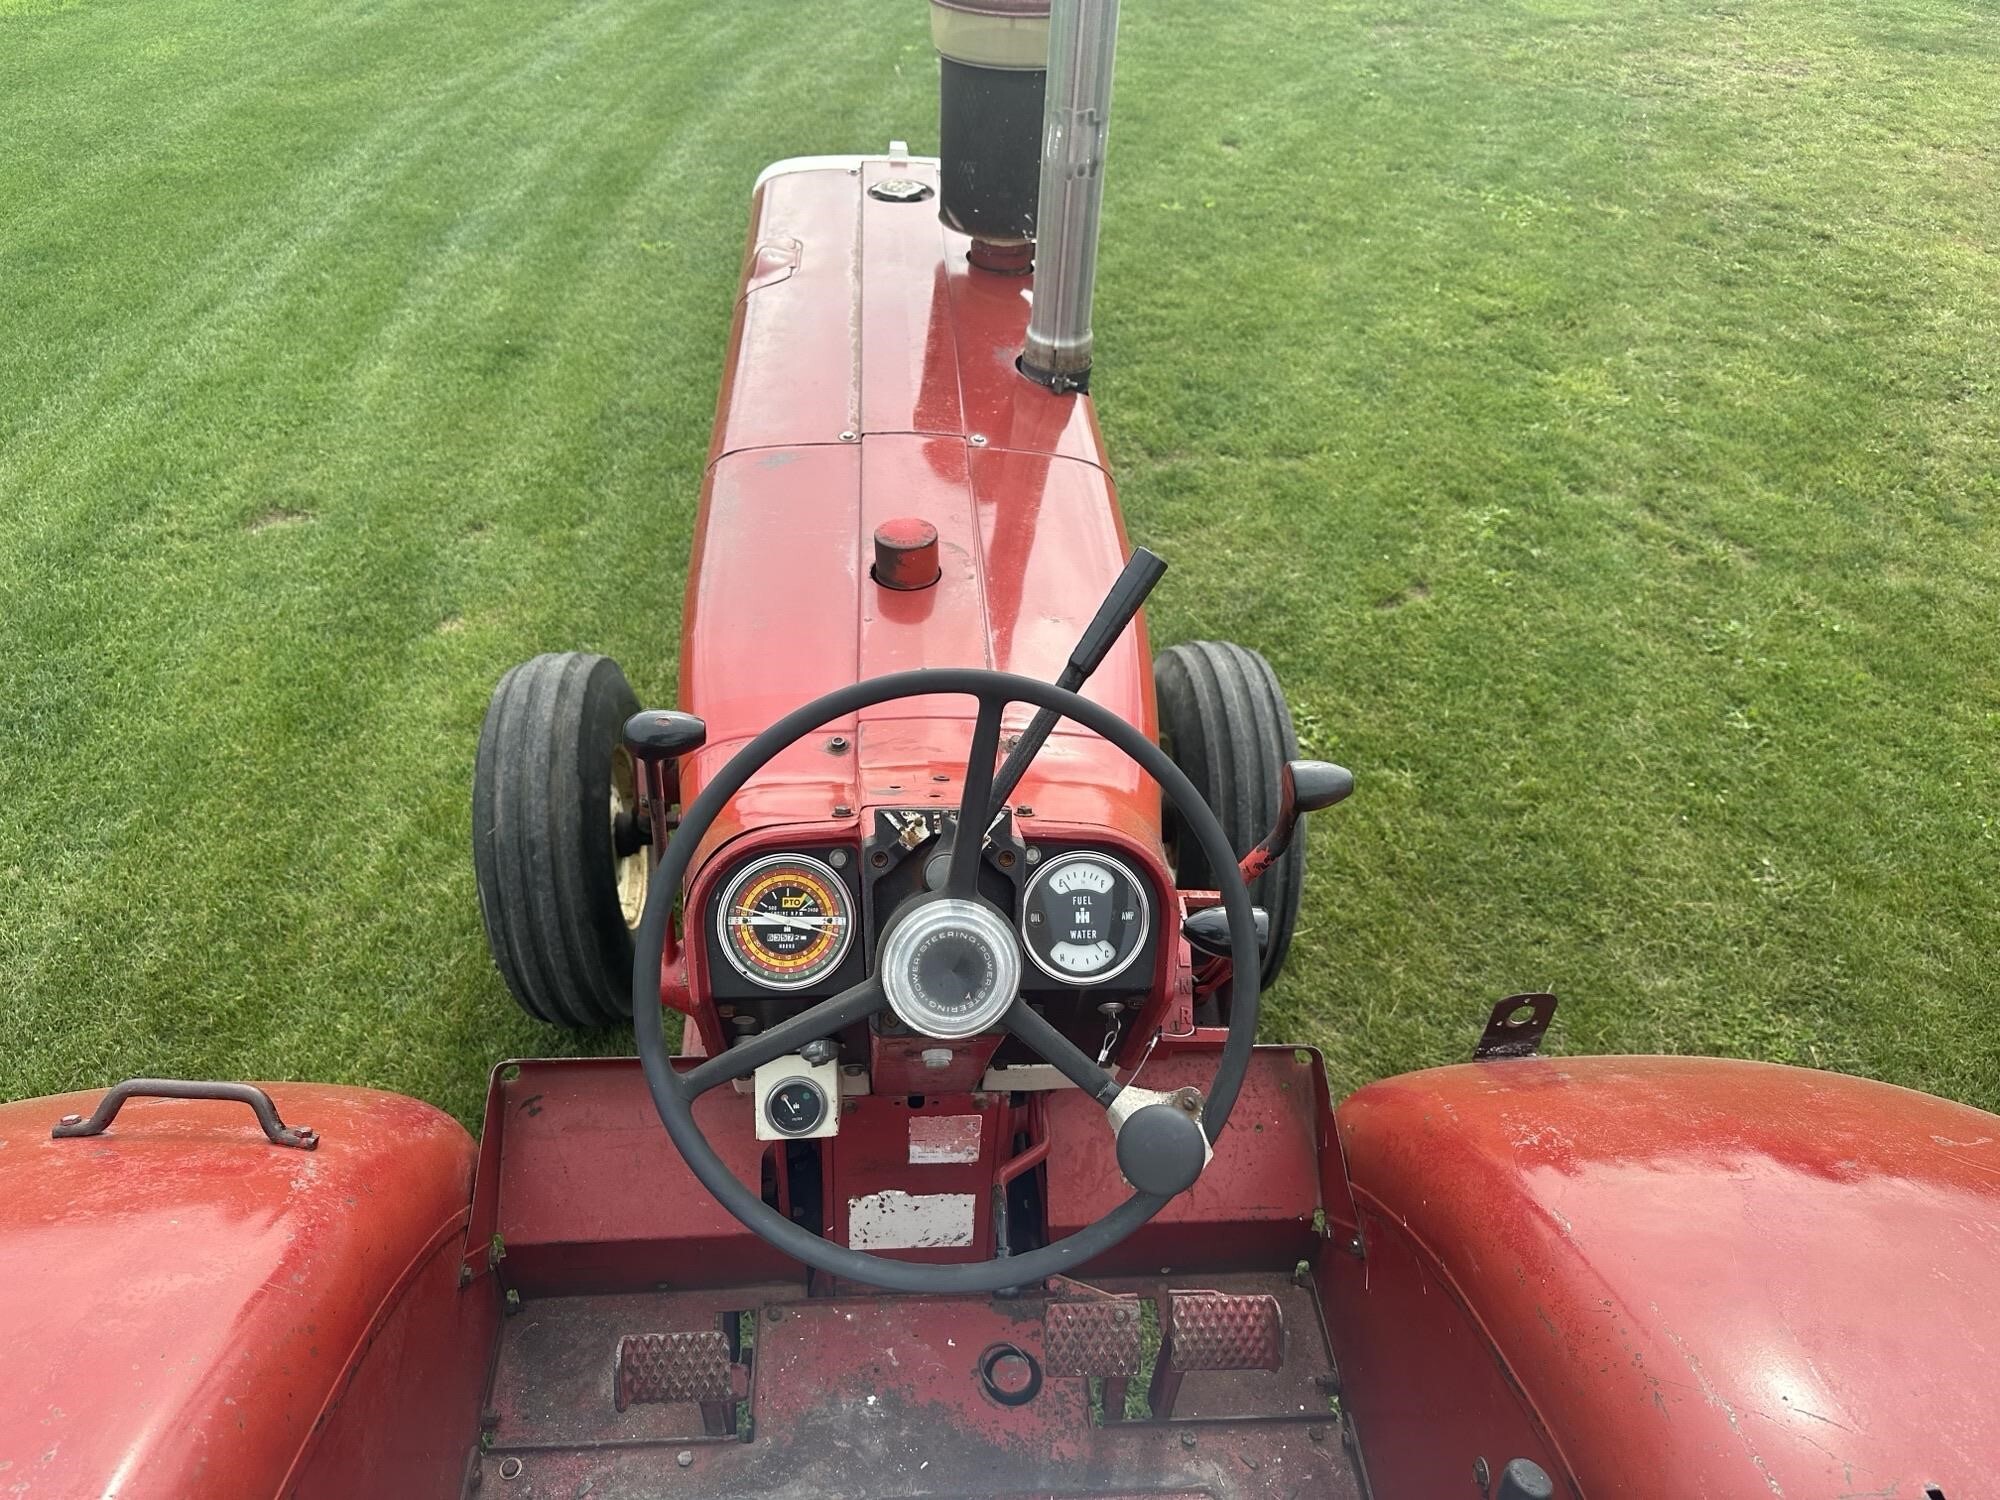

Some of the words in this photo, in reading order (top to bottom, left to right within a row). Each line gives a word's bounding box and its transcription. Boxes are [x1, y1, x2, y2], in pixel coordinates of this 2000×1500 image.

[1058, 878, 1064, 888] E
[1100, 880, 1105, 888] F
[1072, 896, 1092, 906] FUEL
[1030, 913, 1041, 922] OIL
[1121, 912, 1134, 921] AMP
[1070, 930, 1097, 939] WATER
[1104, 950, 1110, 959] C
[911, 958, 925, 1000] POWER
[920, 931, 977, 953] STEERING
[980, 946, 993, 986] POWER
[928, 991, 986, 1014] STEERING
[1180, 1007, 1192, 1024] R
